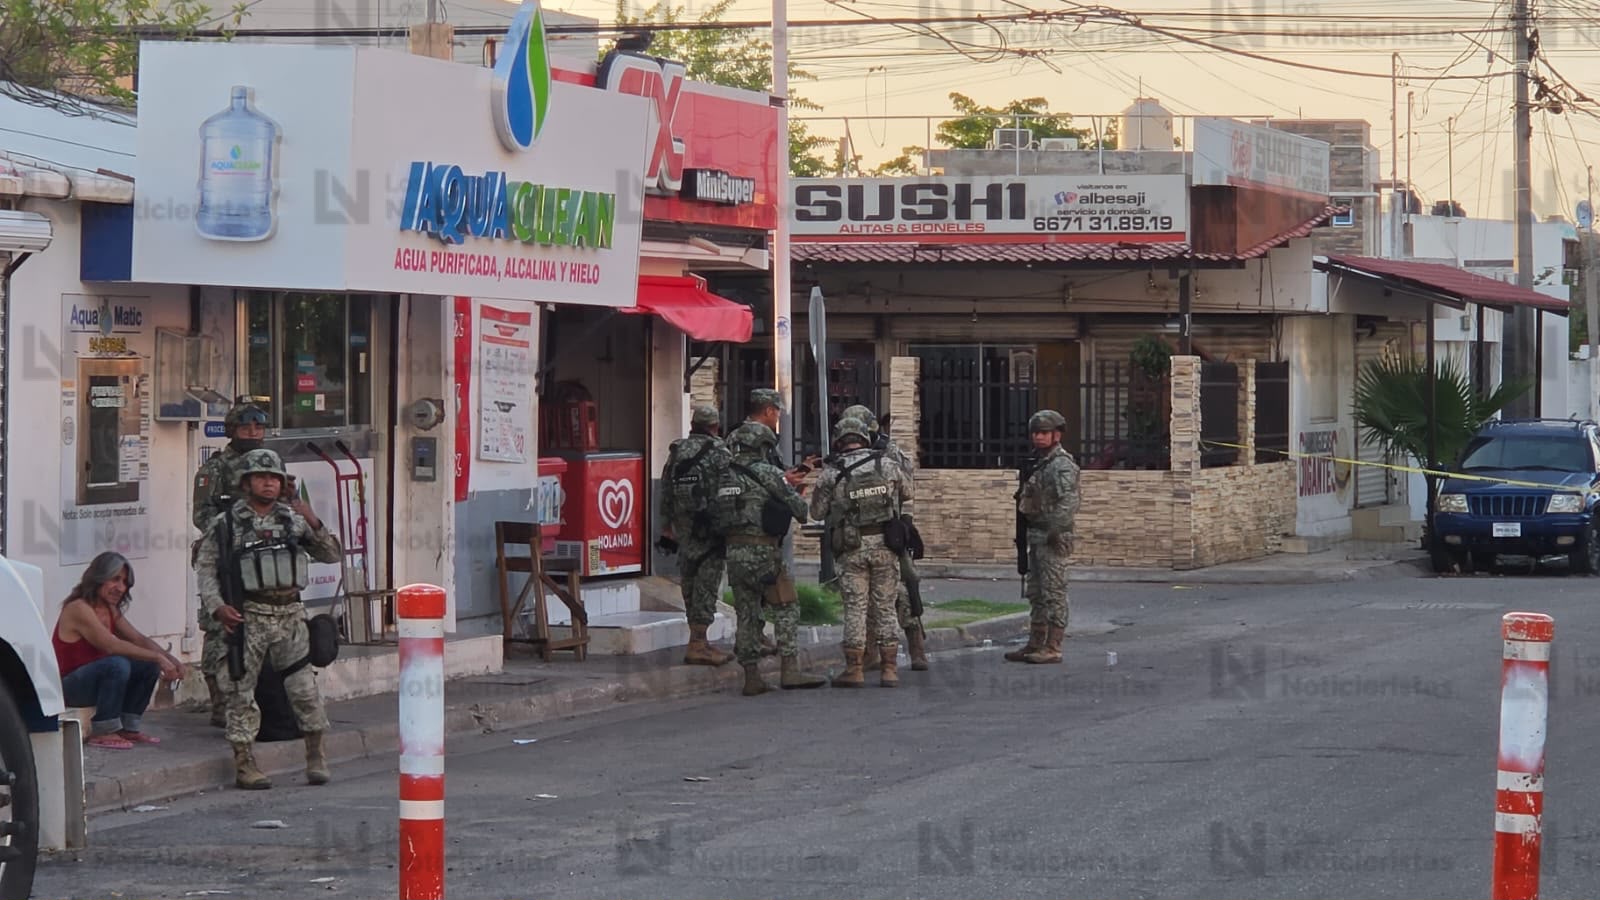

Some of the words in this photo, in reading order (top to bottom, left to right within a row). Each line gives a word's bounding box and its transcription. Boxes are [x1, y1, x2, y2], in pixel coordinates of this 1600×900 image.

[695, 170, 756, 206] MiniSuper
[400, 161, 616, 249] AQUACLEAN
[1079, 192, 1146, 206] albesaji
[1057, 208, 1097, 216] servicio
[1107, 207, 1151, 215] domicilio
[839, 223, 894, 233] ALITAS
[896, 223, 907, 233] &
[911, 223, 985, 233] BONELES
[1033, 216, 1083, 231] 6671
[1089, 216, 1173, 231] 31.89.19
[394, 247, 427, 272] AGUA
[430, 251, 501, 281] PURIFICADA,
[504, 257, 556, 282] ALCALINA
[560, 263, 567, 281] Y
[569, 263, 600, 284] HIELO
[70, 304, 99, 329] Aqua
[114, 305, 143, 326] Matic
[598, 533, 633, 549] HOLANDA
